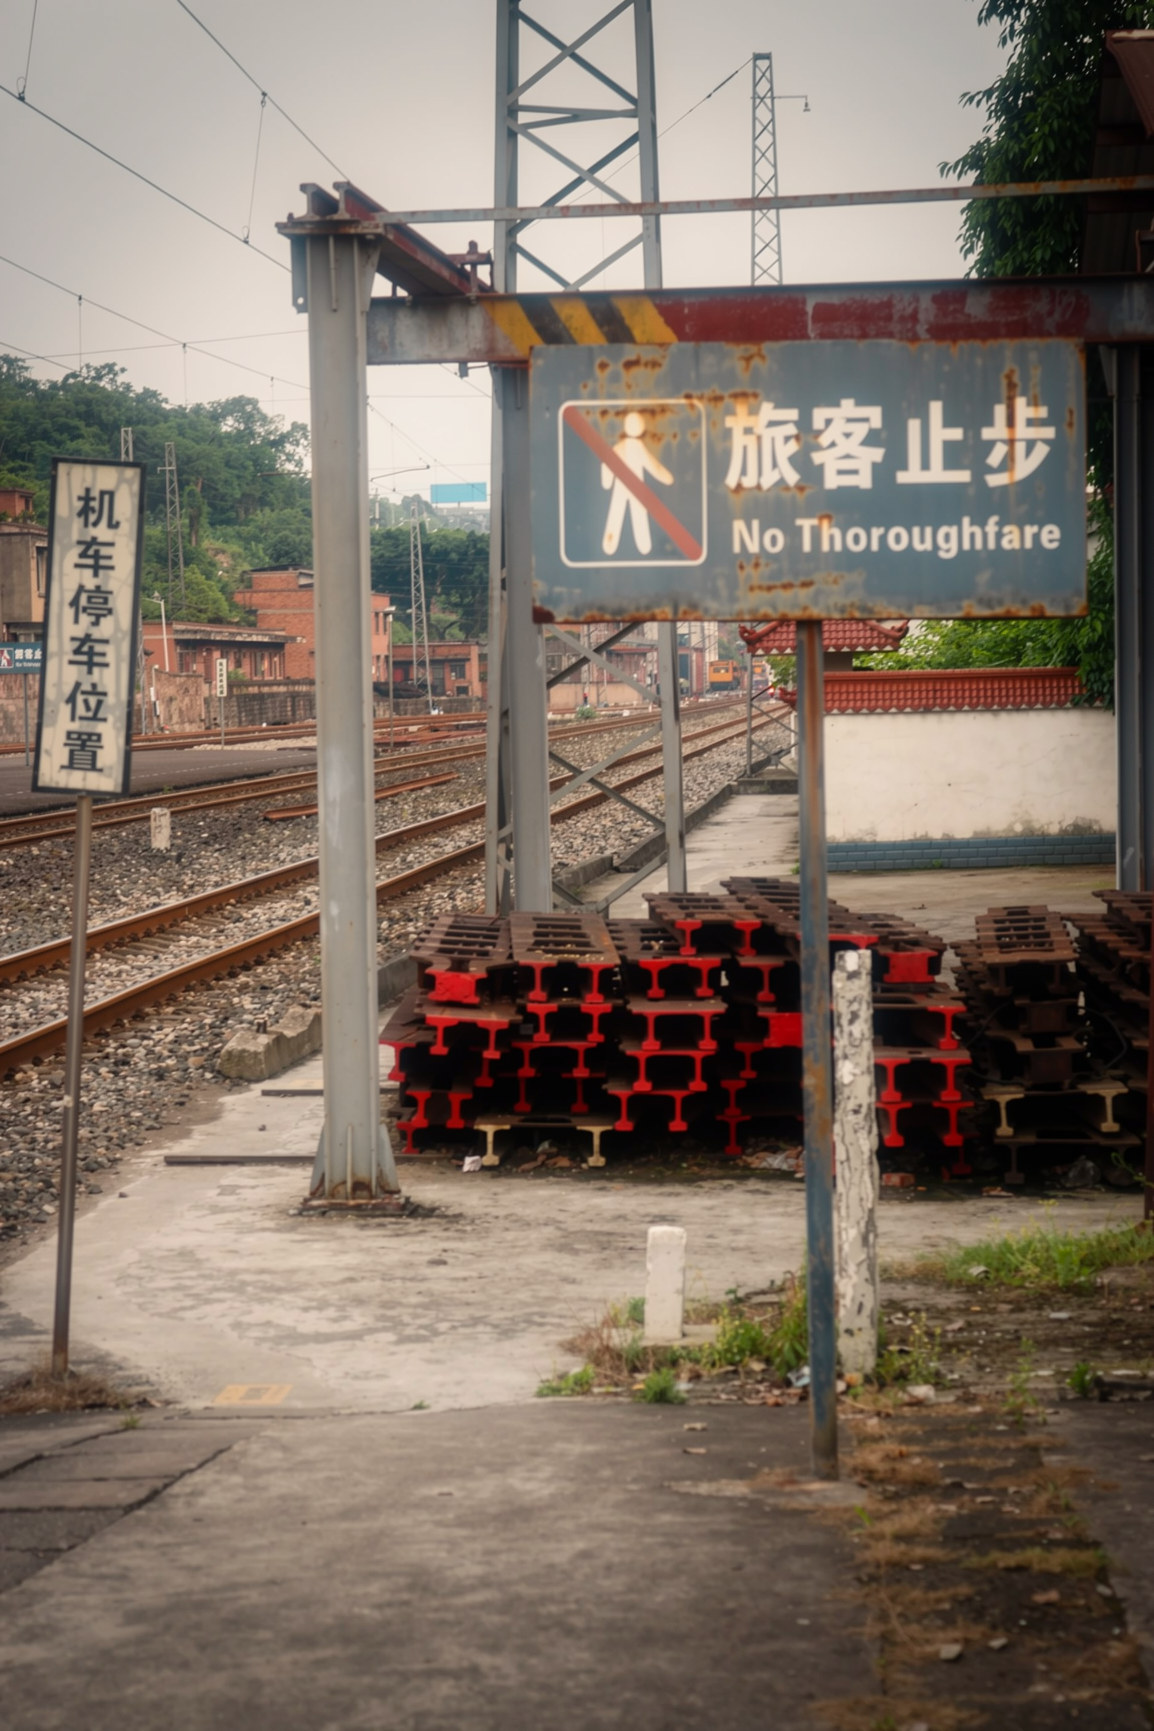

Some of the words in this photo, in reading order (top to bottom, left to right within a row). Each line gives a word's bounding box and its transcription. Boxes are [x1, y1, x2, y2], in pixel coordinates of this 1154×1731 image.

[724, 397, 1056, 491] 旅客止步
[732, 518, 785, 554] No
[795, 515, 1062, 560] Thoroughfare
[60, 486, 121, 774] 机车停车位置
